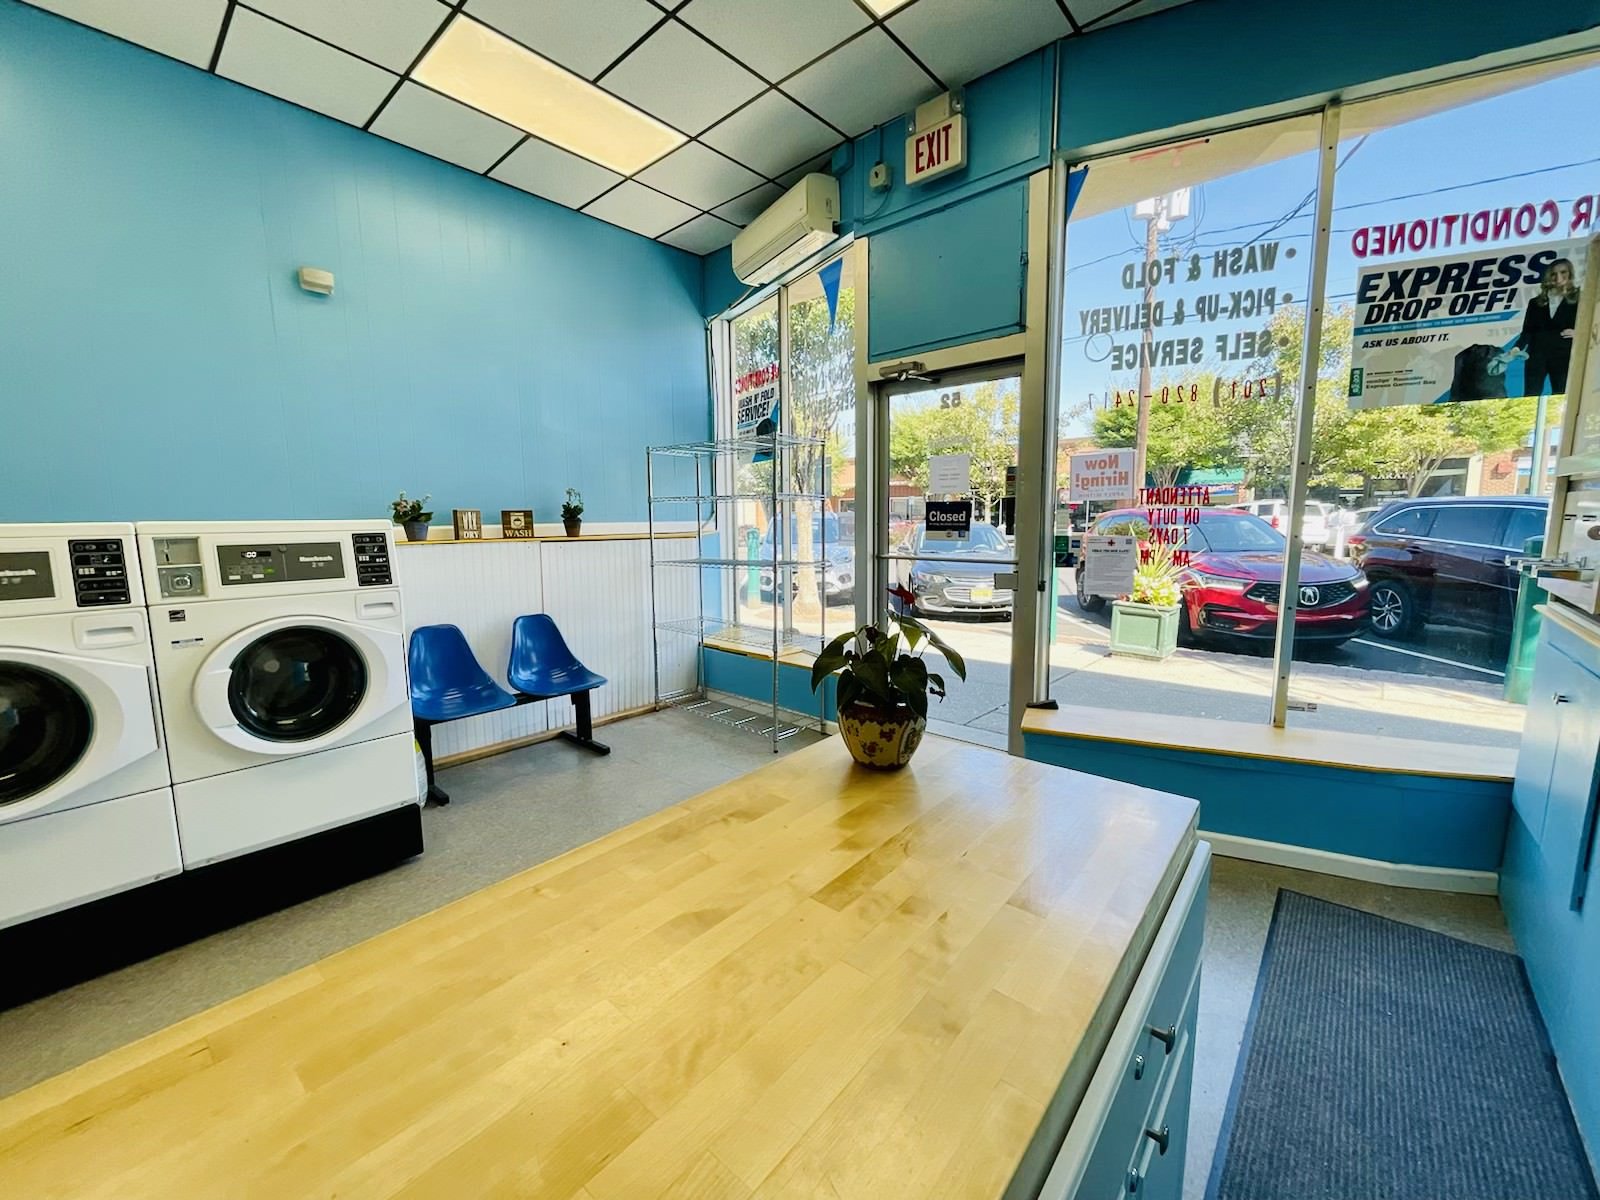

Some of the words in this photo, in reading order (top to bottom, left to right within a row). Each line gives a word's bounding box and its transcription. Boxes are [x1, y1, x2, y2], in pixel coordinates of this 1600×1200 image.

[915, 123, 952, 175] EXIT
[1357, 250, 1557, 304] EXPRESS
[1364, 297, 1442, 325] DROP
[1449, 288, 1518, 316] OFF!
[1362, 340, 1383, 349] ASK
[1385, 338, 1399, 347] US
[1401, 335, 1436, 345] ABOUT
[1438, 333, 1449, 341] IT.
[929, 510, 966, 521] Closed
[463, 530, 480, 539] DRY
[504, 529, 532, 537] WASH
